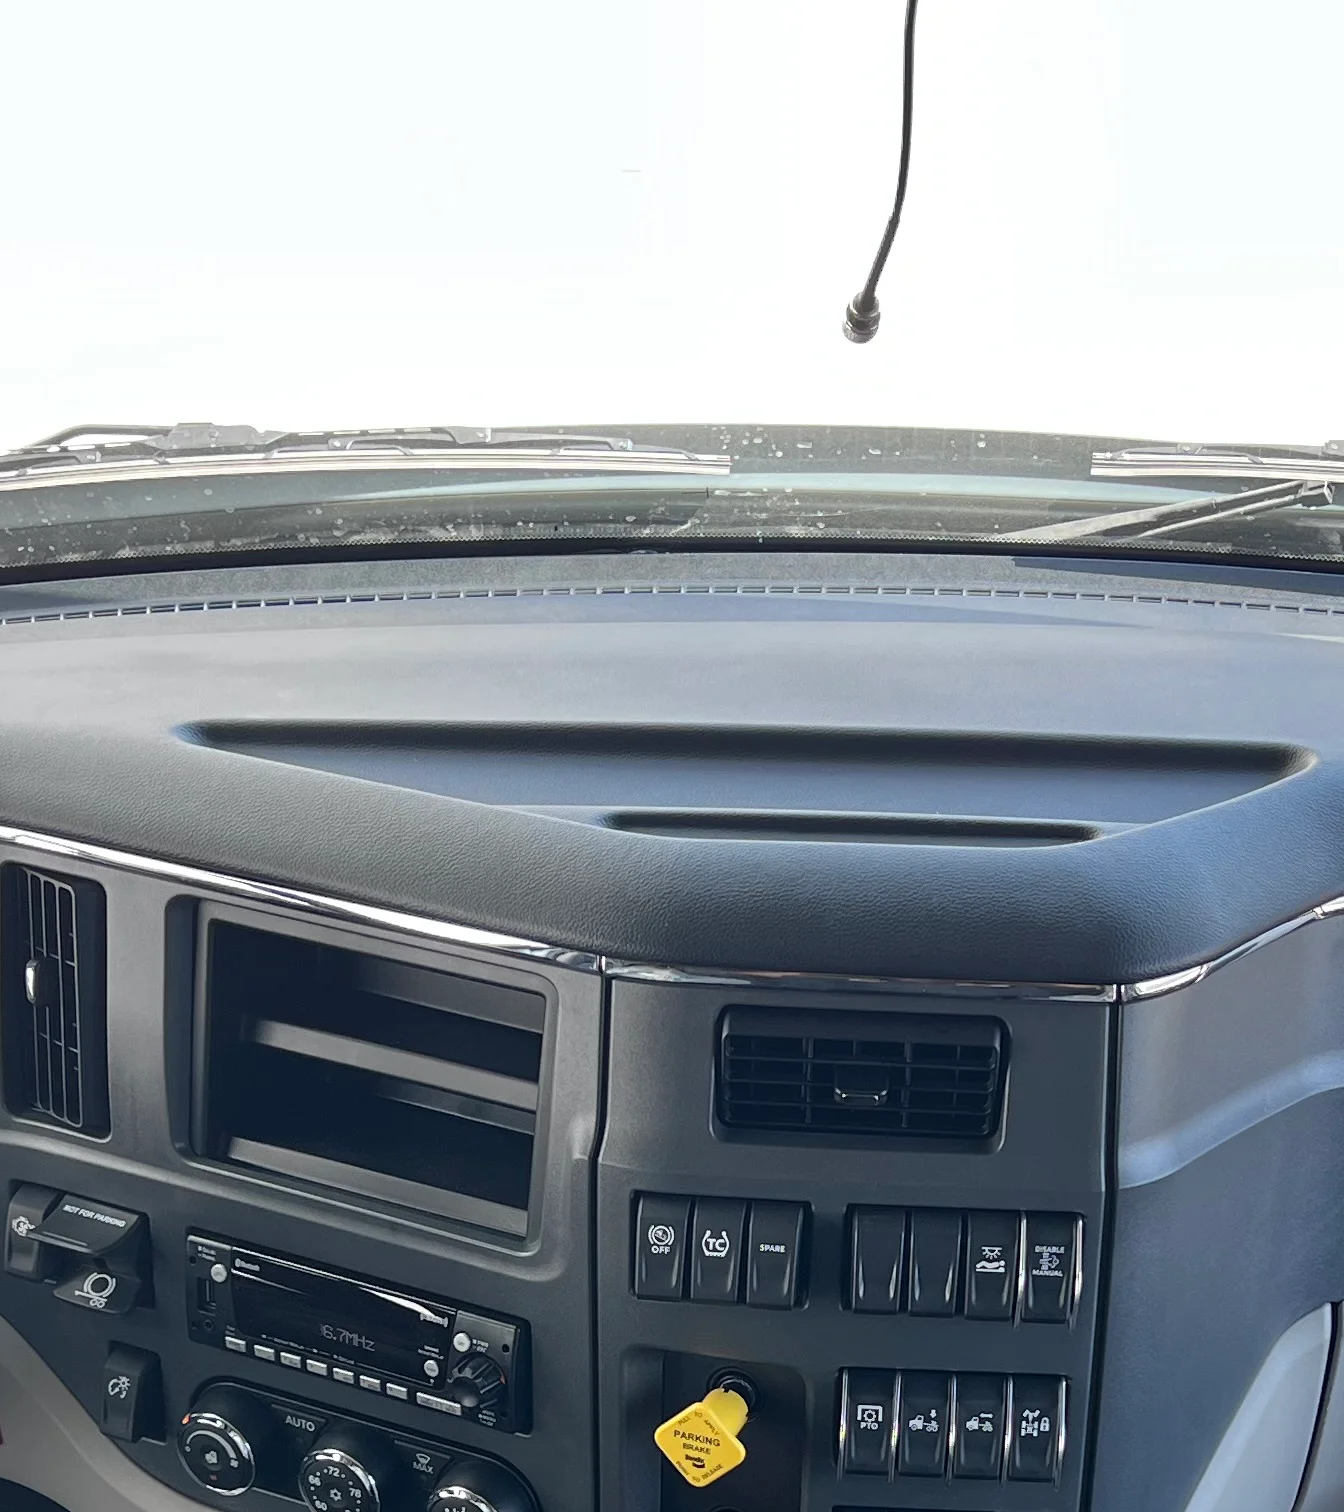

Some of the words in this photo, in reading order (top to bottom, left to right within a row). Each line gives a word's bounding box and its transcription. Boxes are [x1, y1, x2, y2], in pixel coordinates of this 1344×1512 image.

[63, 1204, 80, 1214] NOT
[78, 1208, 95, 1219] FOR
[651, 1245, 671, 1255] OFF
[706, 1238, 726, 1252] TC
[759, 1243, 786, 1254] SPARE
[1034, 1245, 1065, 1254] DISABLE
[285, 1415, 316, 1432] AUTO
[860, 1421, 879, 1430] PTO
[673, 1429, 721, 1448] PARKING
[682, 1442, 712, 1455] BRAKE
[327, 1466, 341, 1478] 72
[412, 1461, 434, 1475] MAX
[348, 1487, 362, 1499] 78
[314, 1499, 328, 1512] 60
